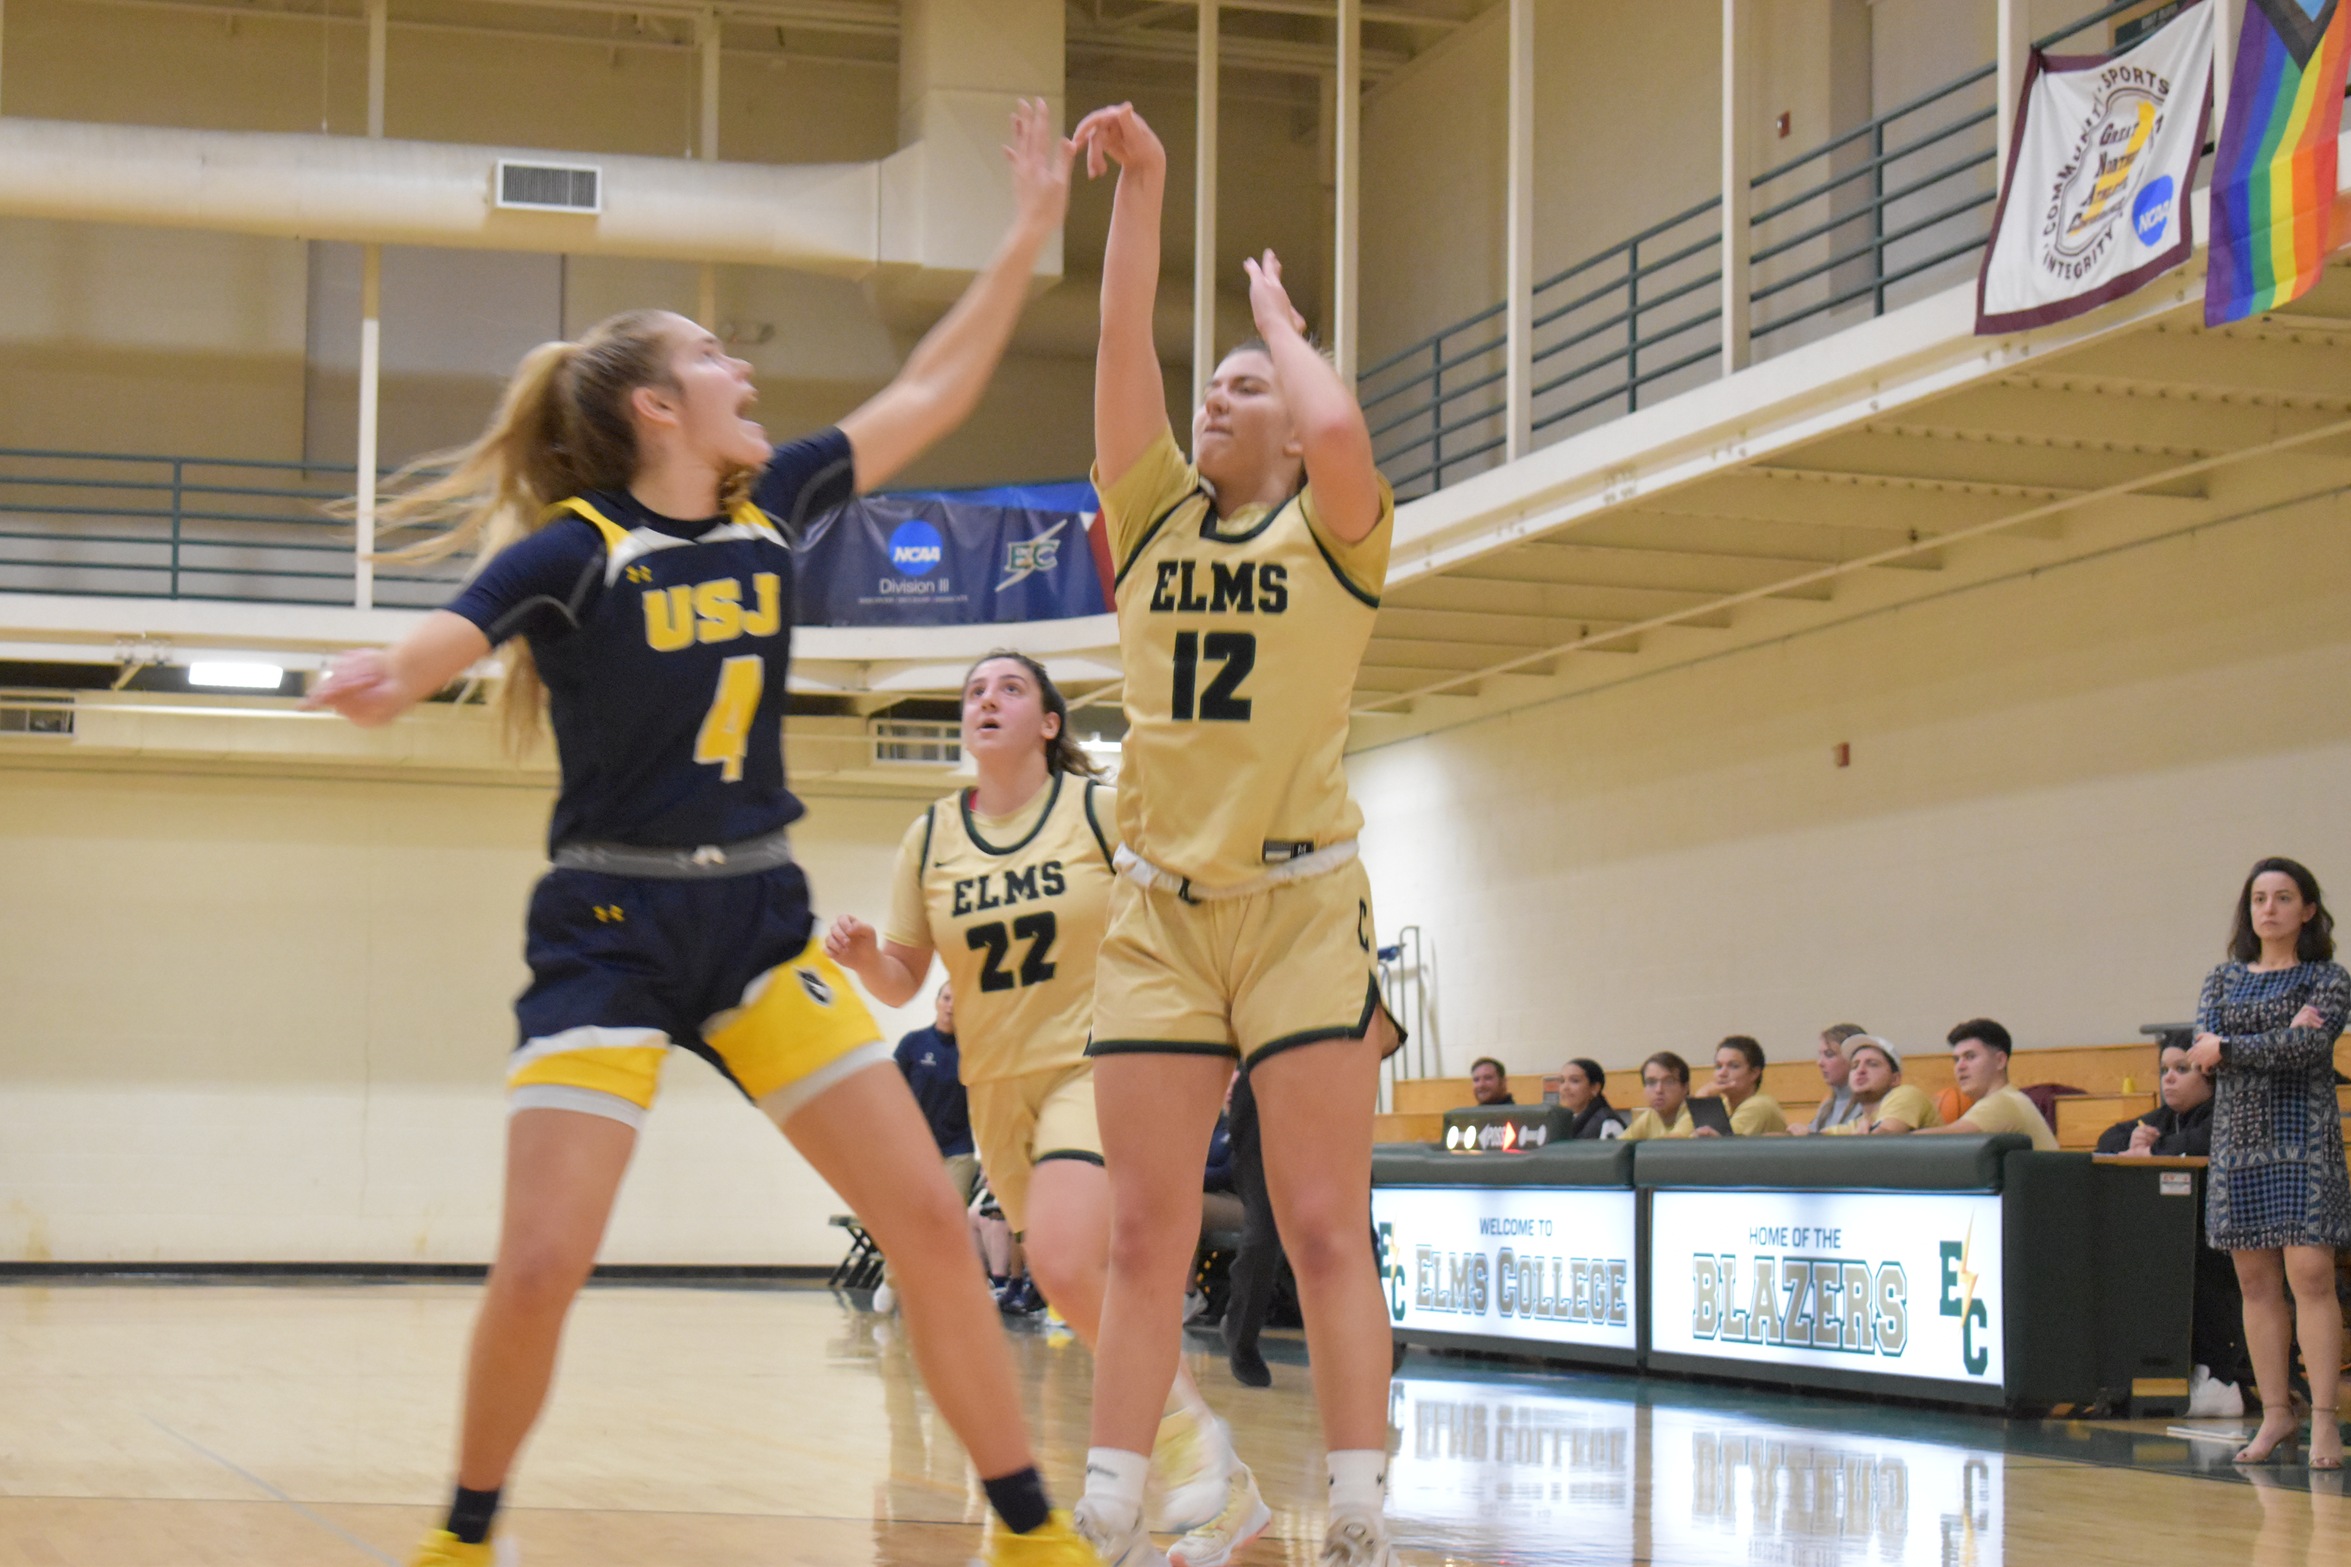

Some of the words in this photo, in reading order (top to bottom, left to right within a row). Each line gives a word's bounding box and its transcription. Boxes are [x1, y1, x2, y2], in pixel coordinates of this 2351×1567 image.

[2043, 221, 2113, 280] INTEGRITY
[893, 546, 941, 563] NCAA
[641, 572, 782, 652] USJ
[879, 577, 935, 595] Division
[938, 577, 950, 593] III
[1149, 559, 1289, 615] ELMS
[1171, 630, 1257, 722] 12
[692, 653, 765, 784] 4
[951, 860, 1067, 917] ELMS
[965, 910, 1057, 993] 22
[1479, 1217, 1535, 1237] WELCOME
[1538, 1219, 1553, 1237] TO
[1749, 1225, 1788, 1248] HOME
[1791, 1227, 1810, 1249] OF
[1813, 1227, 1842, 1250] THE
[1415, 1243, 1490, 1317] ELMS
[1495, 1246, 1628, 1327] COLLEGE
[1693, 1252, 1908, 1358] BLAZERS
